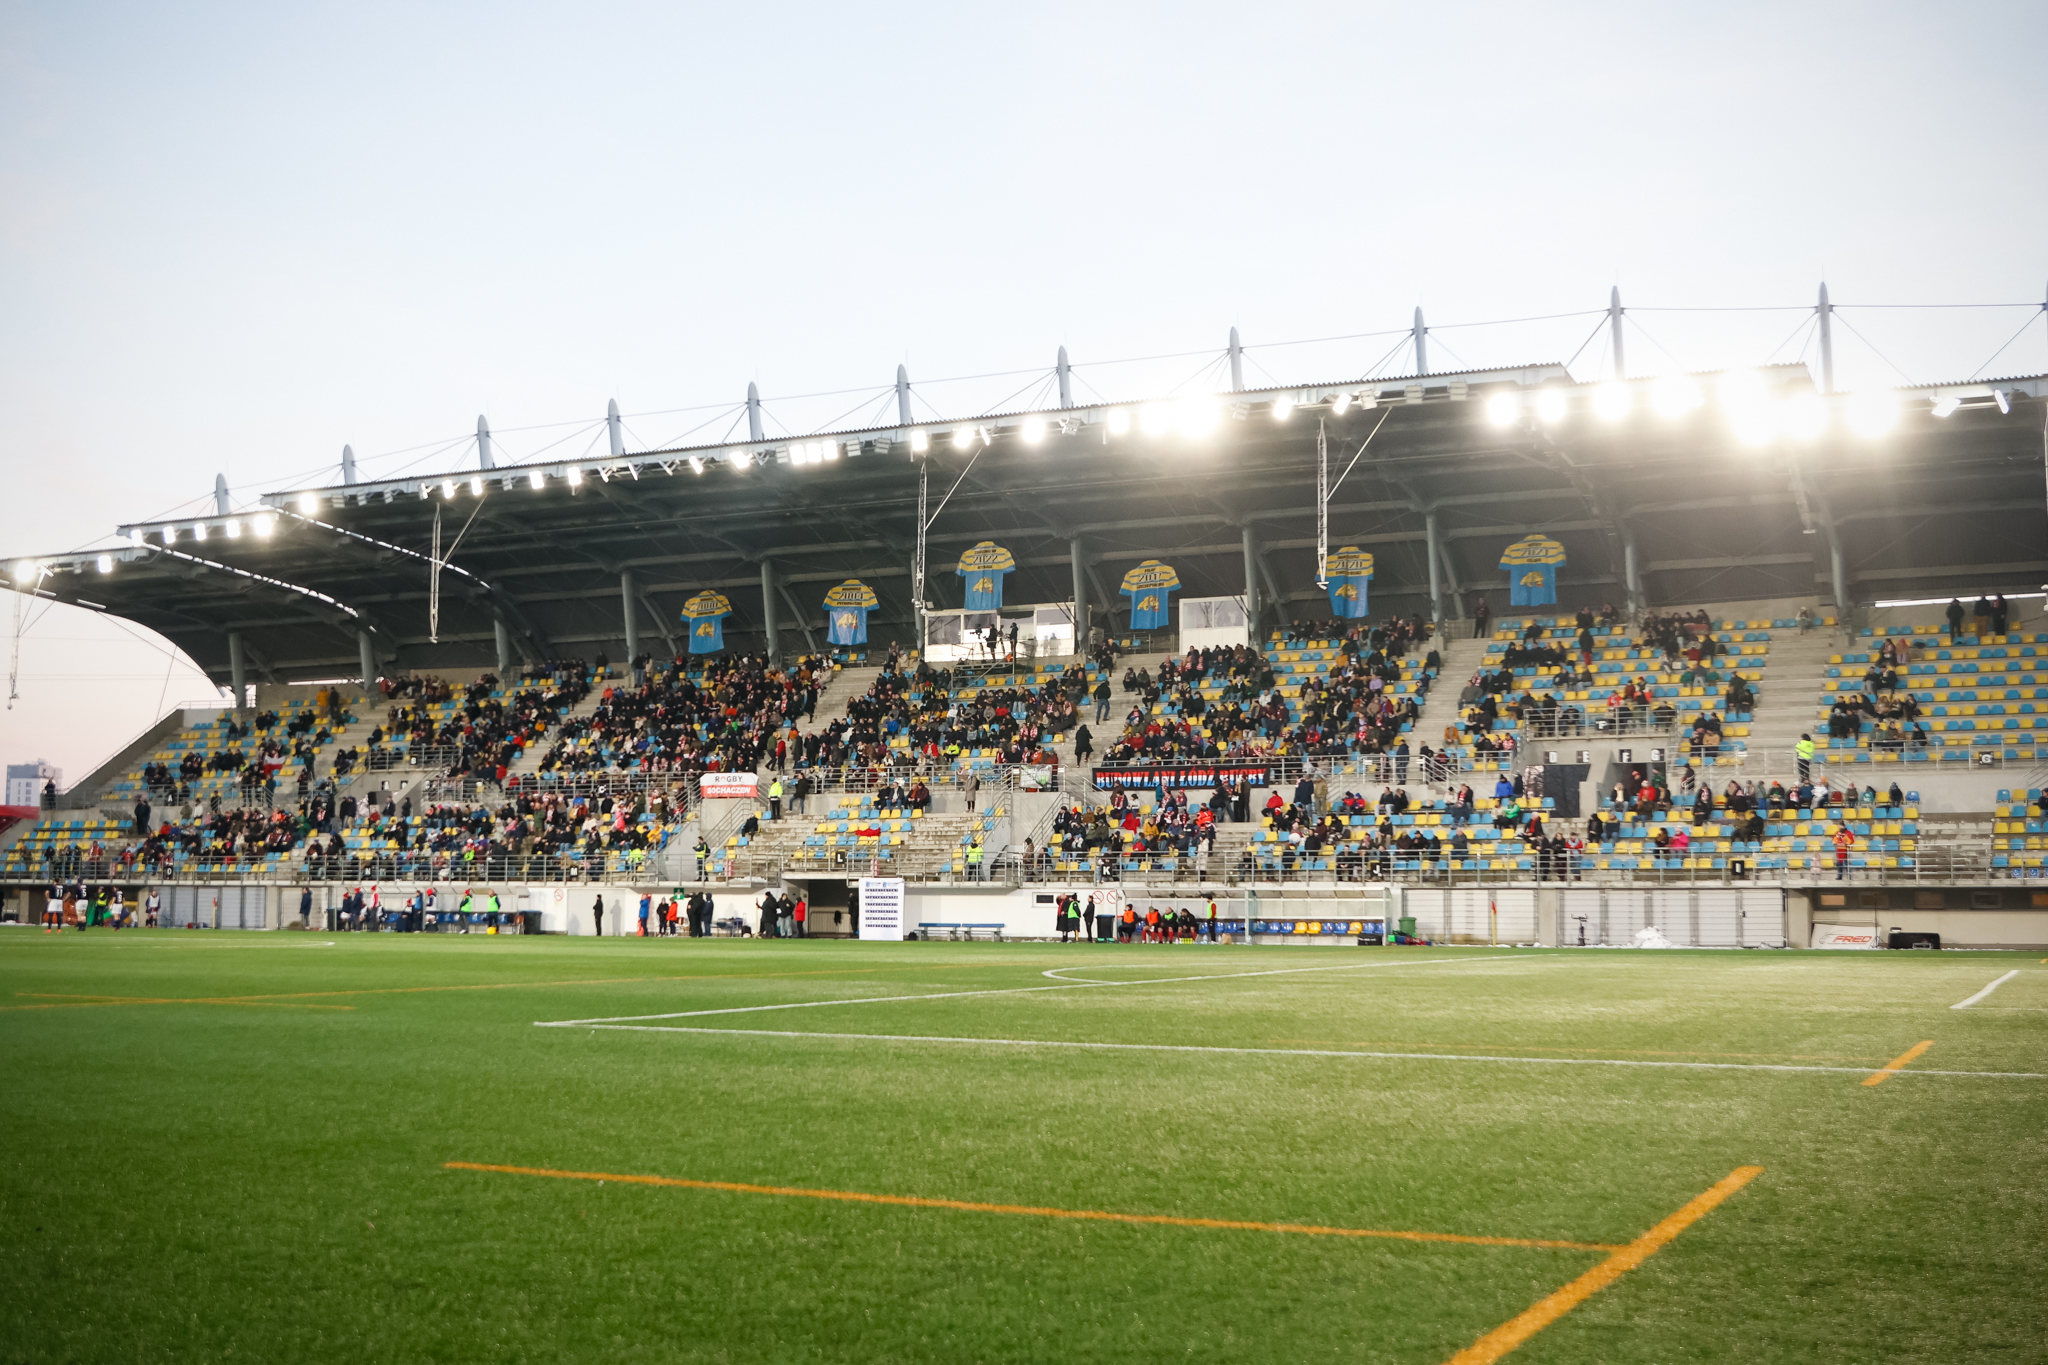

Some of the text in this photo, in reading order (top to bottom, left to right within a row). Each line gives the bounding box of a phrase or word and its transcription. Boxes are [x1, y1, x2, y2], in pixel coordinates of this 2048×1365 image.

[973, 553, 999, 564] 2022
[1549, 751, 1557, 763] D
[1583, 751, 1590, 763] E
[1622, 752, 1630, 763] F
[1651, 749, 1660, 761] G
[1096, 771, 1175, 787] BUDOWLANI
[1179, 765, 1215, 787] ŁÓDŹ
[167, 794, 173, 802] A
[837, 853, 843, 863] L
[365, 867, 371, 875] N
[570, 867, 578, 875] M
[1103, 866, 1111, 876] K
[1372, 864, 1380, 874] J
[56, 889, 63, 897] 11
[82, 888, 87, 897] 5
[1832, 935, 1873, 943] FRED
